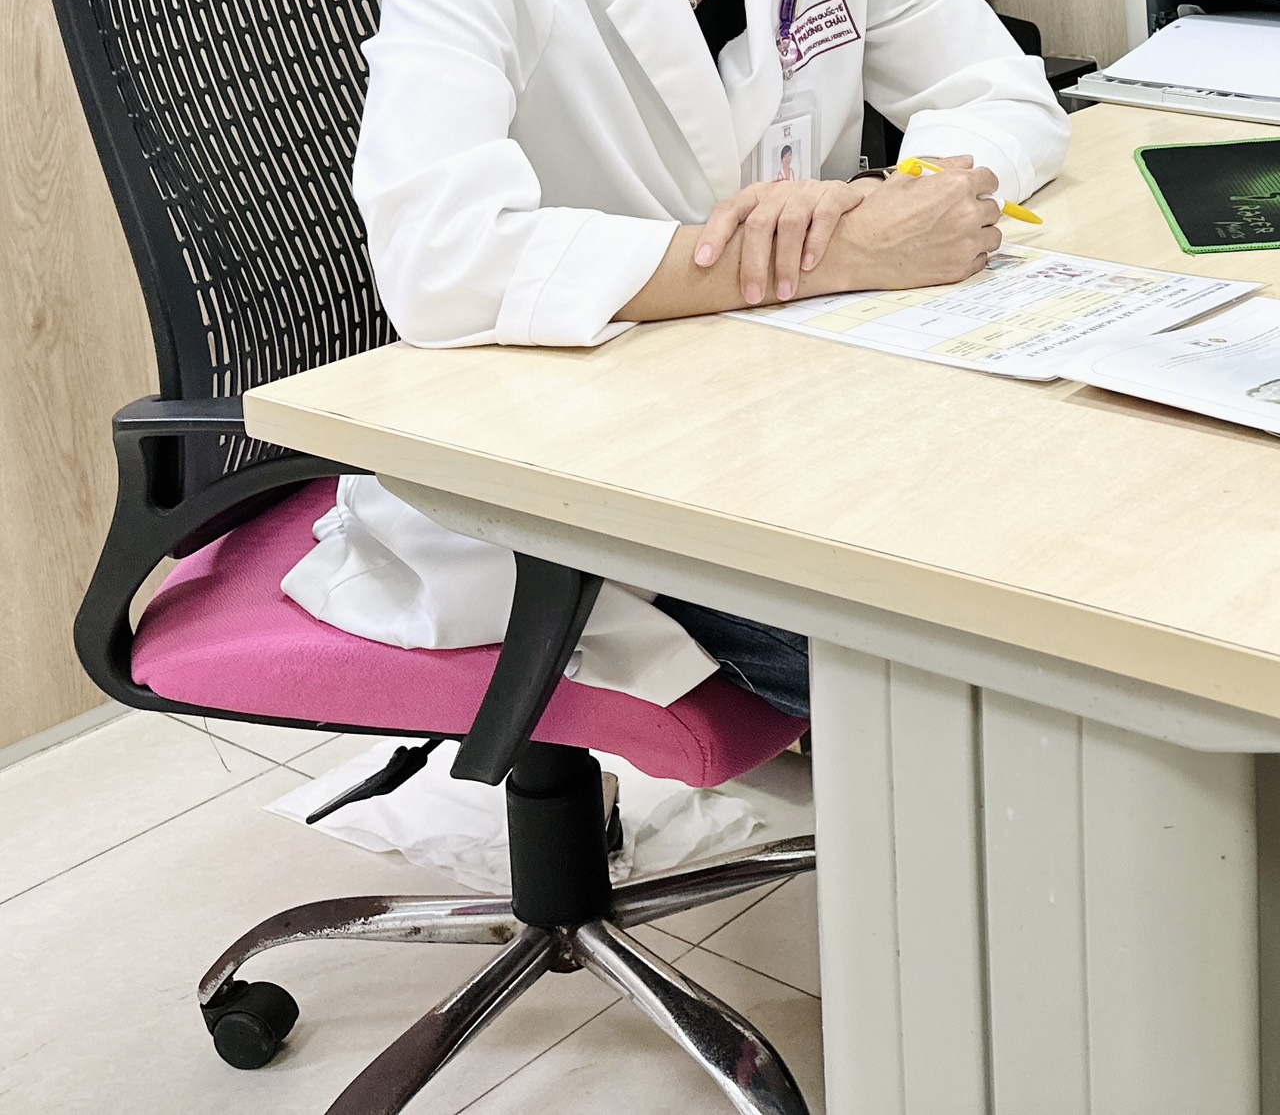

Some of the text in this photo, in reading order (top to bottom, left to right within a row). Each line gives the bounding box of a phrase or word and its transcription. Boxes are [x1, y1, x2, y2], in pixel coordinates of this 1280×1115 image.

[798, 14, 847, 44] PHƯƠNG CHÂU
[1232, 205, 1275, 234] RAZER
